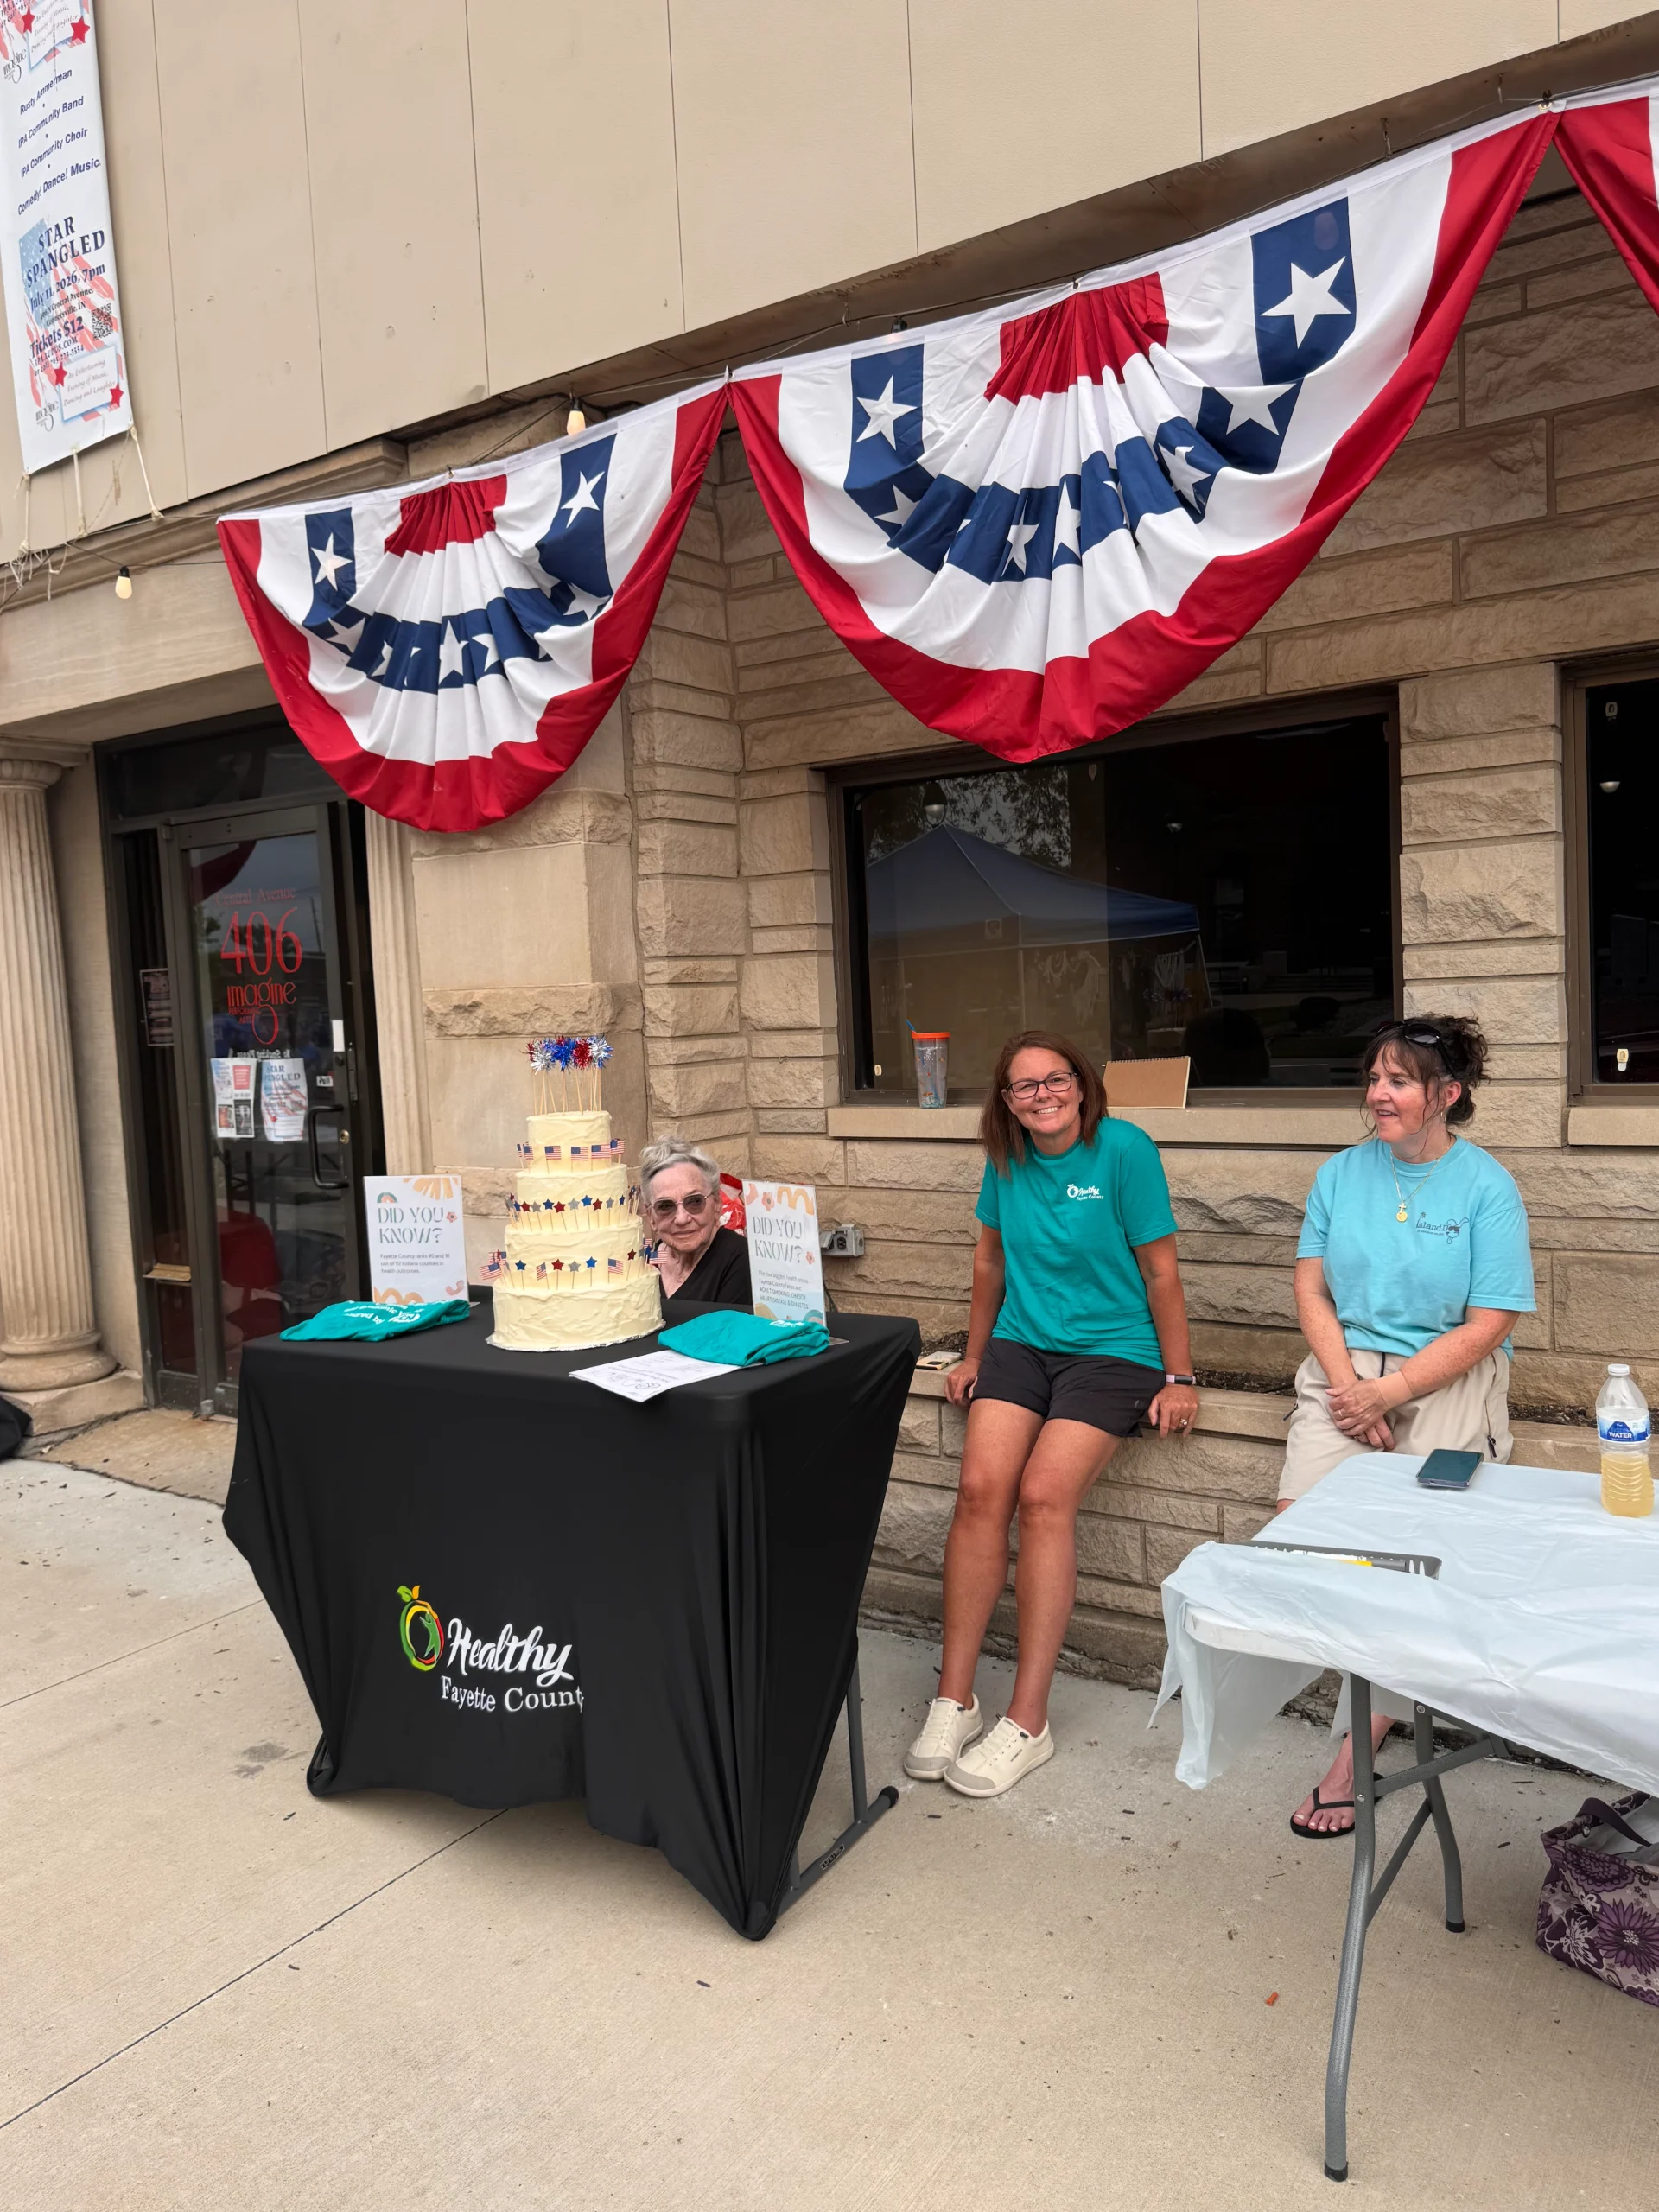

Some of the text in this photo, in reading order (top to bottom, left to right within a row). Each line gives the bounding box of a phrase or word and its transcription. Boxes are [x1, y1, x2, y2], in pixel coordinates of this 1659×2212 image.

[20, 69, 73, 115] Rusty Ammerman
[18, 95, 85, 148] IPA Community Band
[21, 128, 88, 178] IPA Community Choir
[18, 186, 42, 215] Comedy!
[43, 168, 68, 193] Dance!
[39, 216, 76, 254] STAR
[27, 229, 105, 289] SPANGLED
[30, 264, 106, 314] July 11, 2026, 7pm
[52, 296, 69, 311] Central
[78, 301, 86, 310] IN
[30, 316, 85, 359] Tickets $12
[214, 887, 297, 906] Central Avenue
[220, 907, 302, 976] 406
[226, 977, 297, 1045] imagine
[378, 1206, 444, 1224] DID YOU
[753, 1216, 804, 1240] DID YOU
[1416, 1215, 1443, 1231] Island
[378, 1227, 443, 1244] KNOW?
[754, 1239, 804, 1264] KNOW?
[447, 1618, 575, 1688] Healthy
[441, 1675, 585, 1713] Fayette Count
